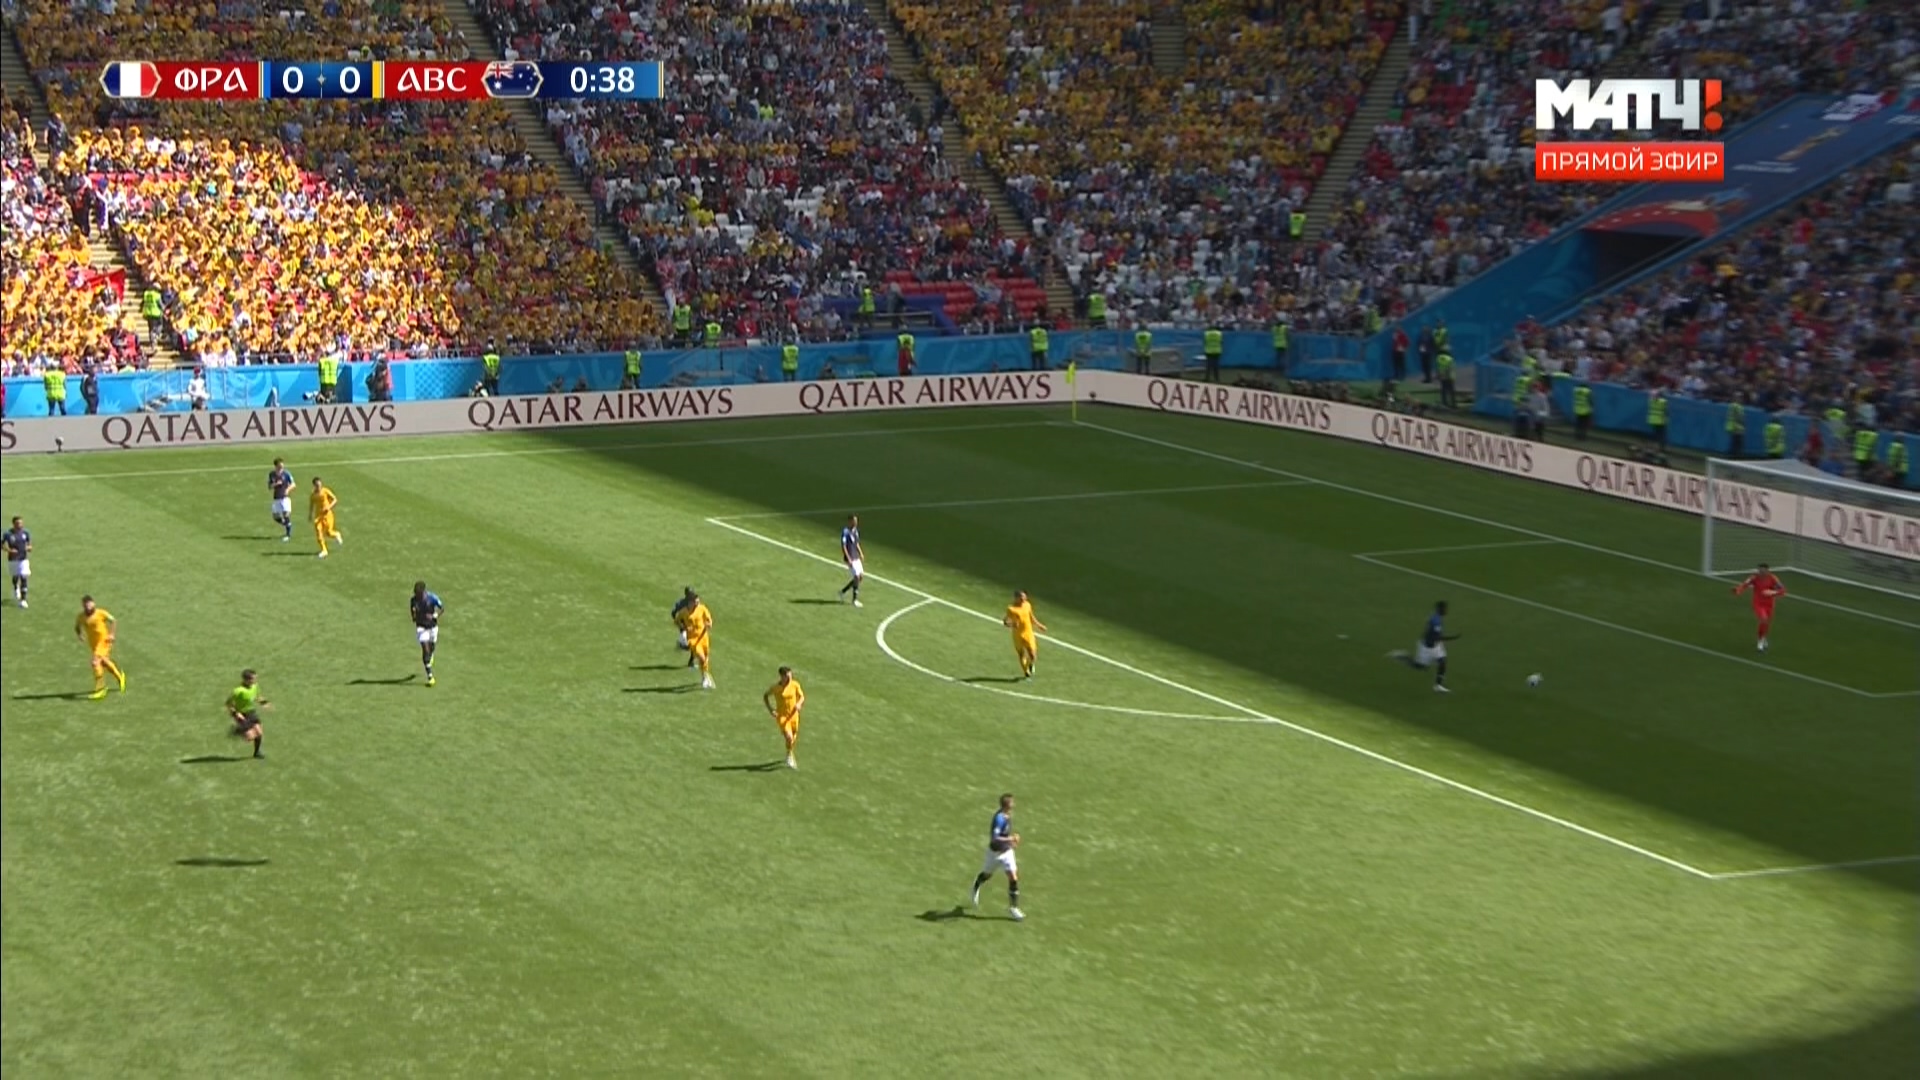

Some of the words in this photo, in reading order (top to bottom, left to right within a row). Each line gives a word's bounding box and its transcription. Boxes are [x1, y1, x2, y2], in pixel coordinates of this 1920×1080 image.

[468, 397, 584, 430] QATAR
[593, 388, 733, 421] AIRWAYS
[799, 380, 907, 413] QATAR
[915, 373, 1052, 404] AIRWAYS
[1147, 379, 1229, 414] QATAR
[1236, 395, 1331, 430] AIRWAYS
[101, 410, 231, 448] QATAR
[242, 404, 397, 438] AIRWAYS
[1371, 412, 1440, 448] QATAR
[1446, 429, 1534, 472] AIRWAYS
[1576, 455, 1656, 497] QATAR
